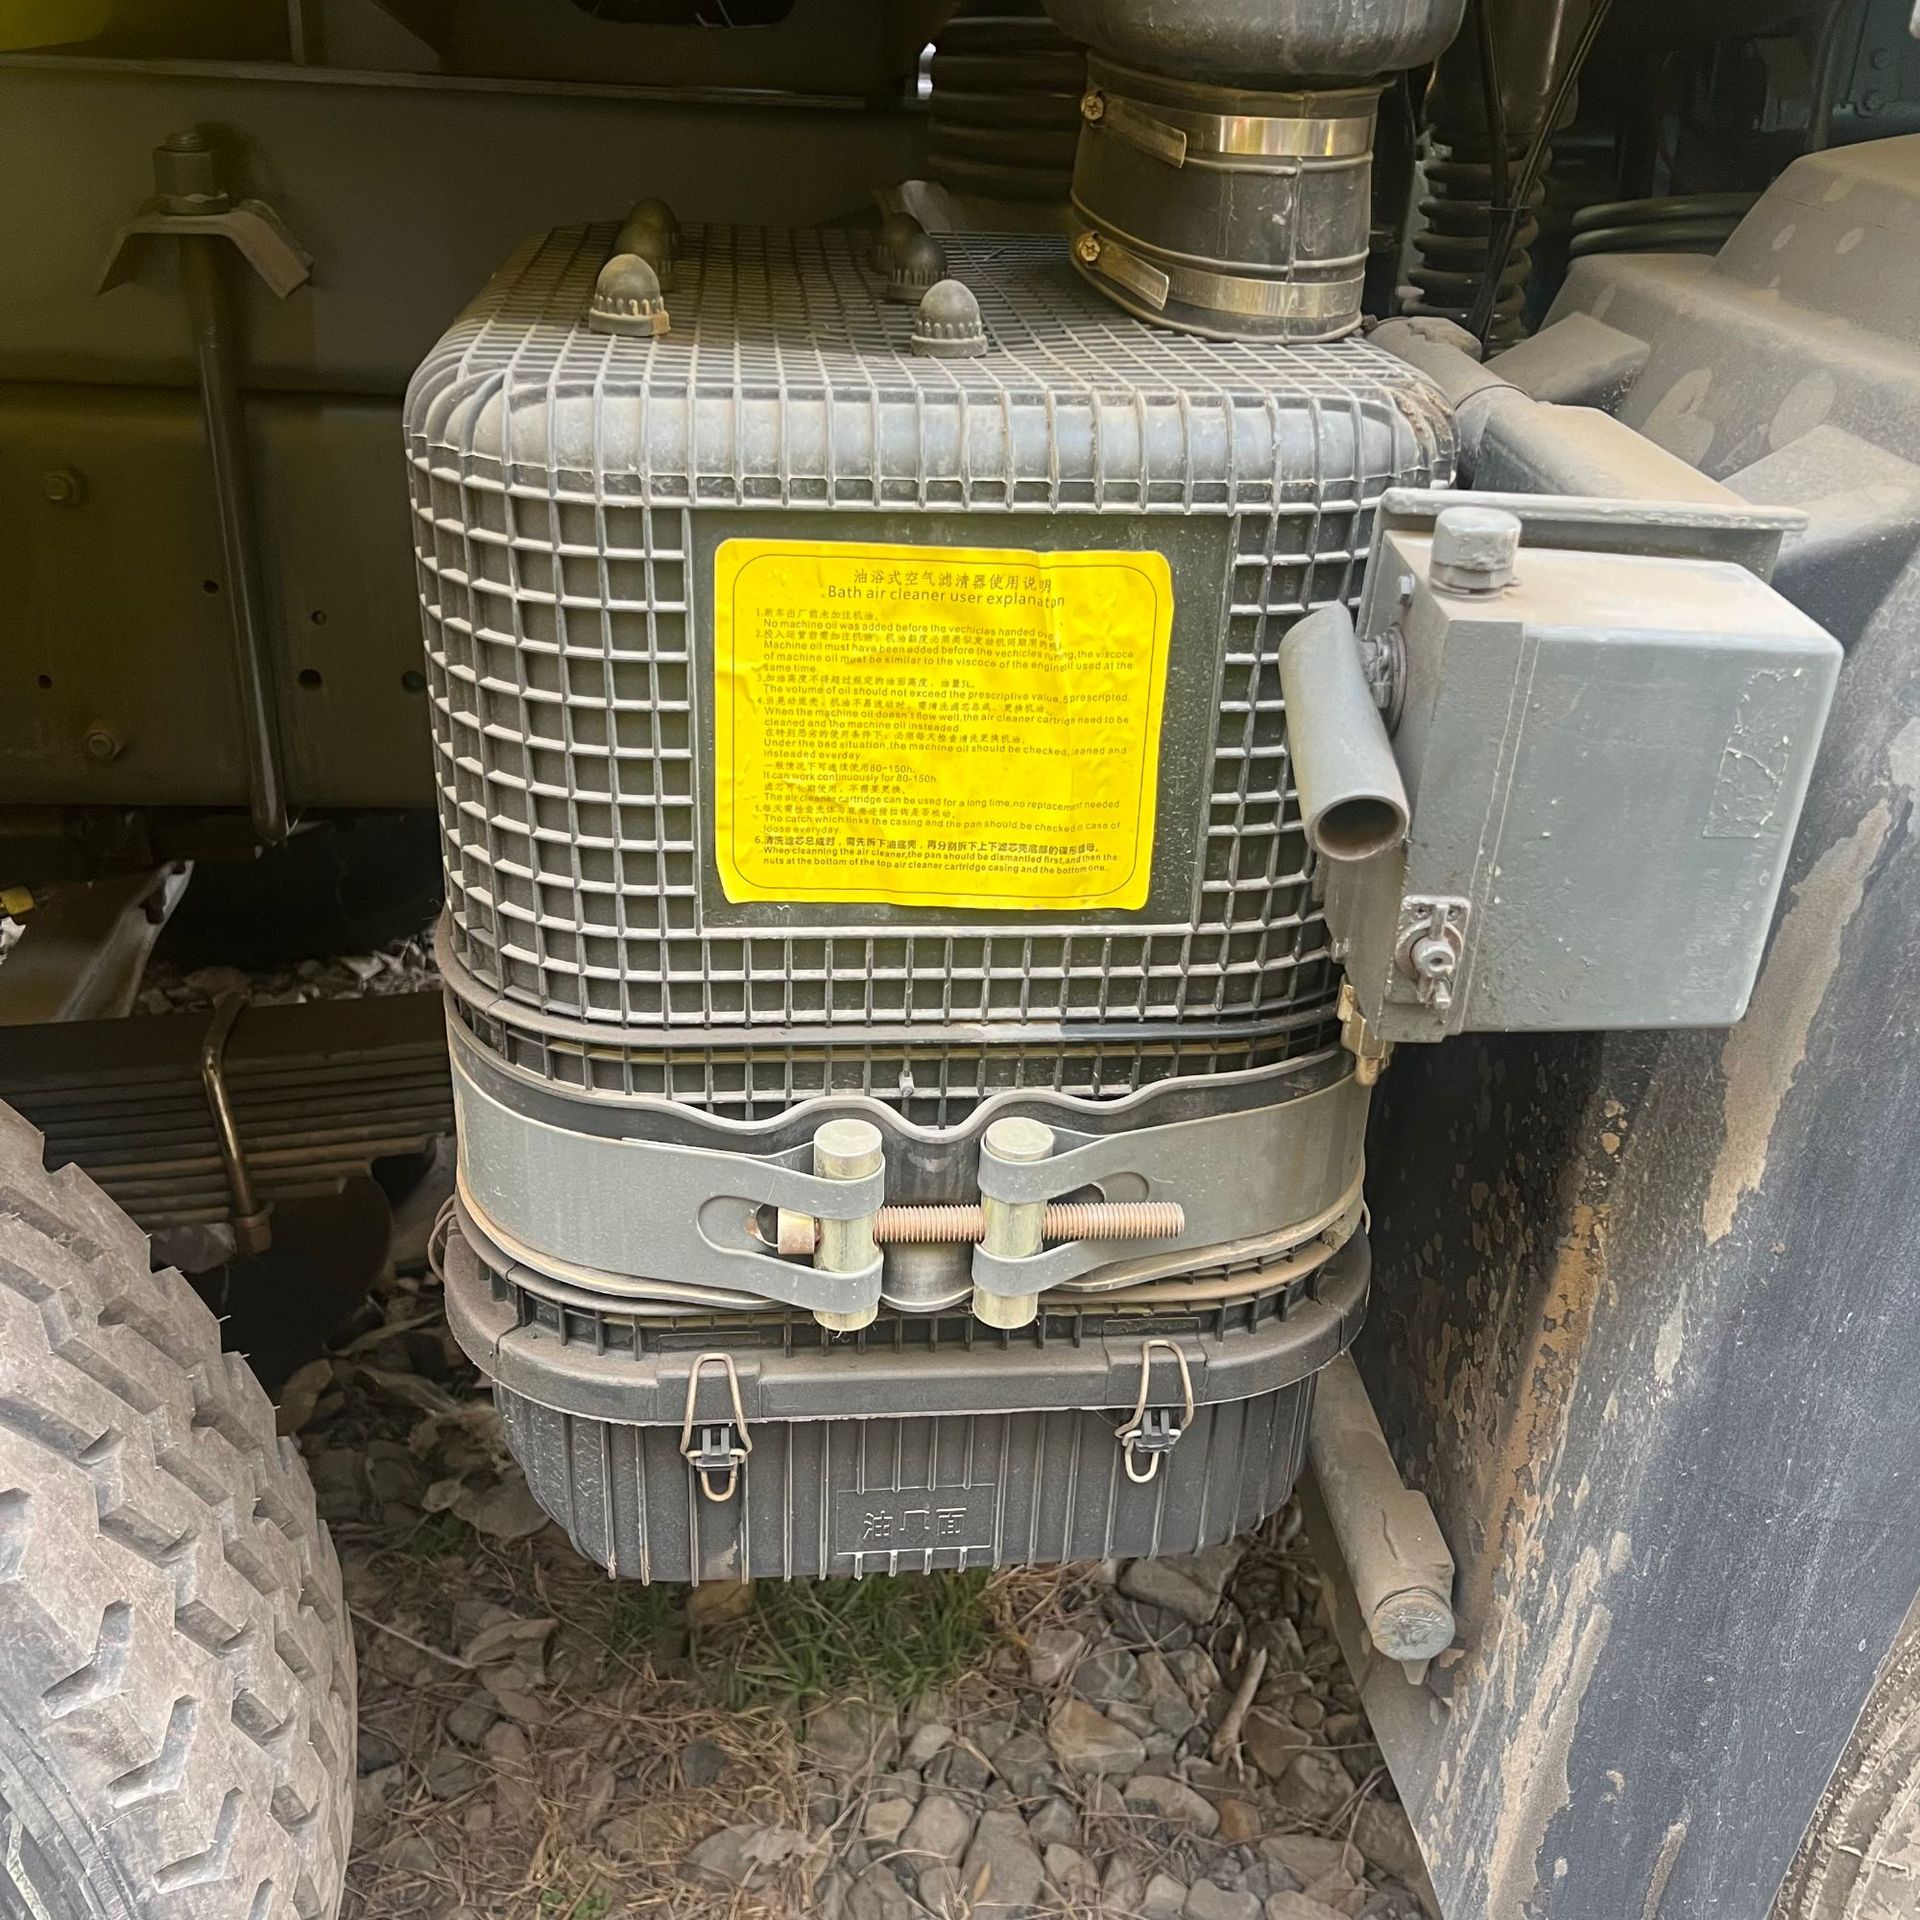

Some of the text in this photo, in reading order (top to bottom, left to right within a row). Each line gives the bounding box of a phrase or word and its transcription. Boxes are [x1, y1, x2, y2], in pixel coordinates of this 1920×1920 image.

[854, 568, 1052, 594] 油浴式空气滤清器使用说明
[828, 585, 862, 598] Bath
[866, 587, 886, 599] air
[890, 588, 945, 601] cleaner
[950, 593, 983, 604] user
[764, 619, 778, 627] No
[780, 620, 823, 628] machine
[825, 620, 837, 629] oil
[862, 623, 893, 631] added
[896, 624, 928, 632] before
[930, 624, 946, 632] the
[998, 628, 1035, 637] handed
[764, 641, 807, 649] Machine
[810, 641, 822, 650] oil
[825, 642, 849, 651] must
[852, 644, 876, 652] have
[879, 645, 905, 654] been
[907, 645, 938, 654] added
[941, 646, 975, 655] before
[976, 648, 992, 656] the
[764, 652, 775, 660] of
[777, 653, 822, 661] machine
[825, 654, 838, 662] oil
[841, 655, 866, 664] must
[869, 655, 882, 664] be
[885, 656, 922, 664] similar
[924, 656, 934, 665] to
[936, 657, 953, 665] the
[999, 660, 1010, 668] of
[1012, 660, 1028, 669] the
[1076, 662, 1100, 670] used
[1103, 662, 1114, 670] at
[1116, 662, 1133, 670] the
[765, 684, 783, 692] The
[786, 685, 823, 694] volume
[826, 686, 835, 694] of
[838, 686, 850, 694] oil
[853, 687, 888, 696] should
[890, 688, 907, 696] not
[909, 689, 946, 698] exceed
[950, 690, 965, 699] the
[765, 707, 794, 715] When
[796, 708, 813, 716] the
[815, 709, 858, 717] machine
[861, 709, 873, 718] oil
[916, 711, 937, 720] flow
[982, 712, 996, 721] air
[997, 714, 1034, 722] cleaner
[1078, 715, 1102, 723] need
[1104, 715, 1114, 723] to
[1117, 715, 1129, 723] be
[765, 718, 805, 726] cleaned
[807, 719, 826, 727] and
[829, 720, 845, 728] the
[847, 720, 891, 729] machine
[893, 721, 906, 730] oil
[764, 738, 796, 747] Under
[798, 739, 815, 747] the
[818, 740, 837, 748] bad
[909, 742, 953, 752] machine
[956, 744, 969, 752] oil
[971, 744, 1006, 753] should
[1008, 745, 1020, 753] be
[1108, 746, 1127, 754] and
[764, 771, 771, 779] It
[792, 772, 815, 780] work
[818, 773, 879, 783] continuously
[881, 773, 894, 782] for
[765, 792, 783, 800] The
[785, 793, 799, 801] air
[801, 794, 836, 802] cleaner
[838, 795, 881, 805] cartridge
[903, 796, 916, 804] be
[918, 797, 941, 805] used
[944, 798, 956, 806] for
[967, 799, 987, 809] long
[1084, 800, 1120, 808] needed
[763, 824, 791, 833] loose
[765, 814, 783, 822] The
[785, 815, 812, 823] catch
[815, 815, 844, 824] which
[846, 816, 869, 824] links
[872, 816, 888, 825] the
[890, 818, 923, 828] casing
[925, 819, 943, 827] and
[946, 820, 962, 828] the
[964, 822, 982, 830] pan
[984, 821, 1017, 829] should
[1020, 822, 1032, 830] be
[1034, 823, 1075, 832] checked
[1110, 821, 1120, 829] of
[763, 846, 790, 854] When
[840, 847, 854, 855] the
[857, 847, 869, 855] air
[924, 852, 940, 861] pan
[942, 851, 976, 860] should
[977, 852, 989, 860] be
[1103, 852, 1118, 860] the
[764, 856, 784, 864] nuts
[787, 856, 796, 864] at
[797, 856, 812, 864] the
[814, 857, 847, 865] bottom
[849, 857, 859, 866] of
[861, 857, 875, 866] the
[877, 858, 892, 869] top
[894, 859, 906, 868] air
[908, 860, 942, 869] cleaner
[944, 862, 986, 873] cartridge
[988, 864, 1019, 874] casing
[1021, 865, 1038, 873] and
[1040, 865, 1054, 874] the
[1056, 864, 1087, 874] bottom
